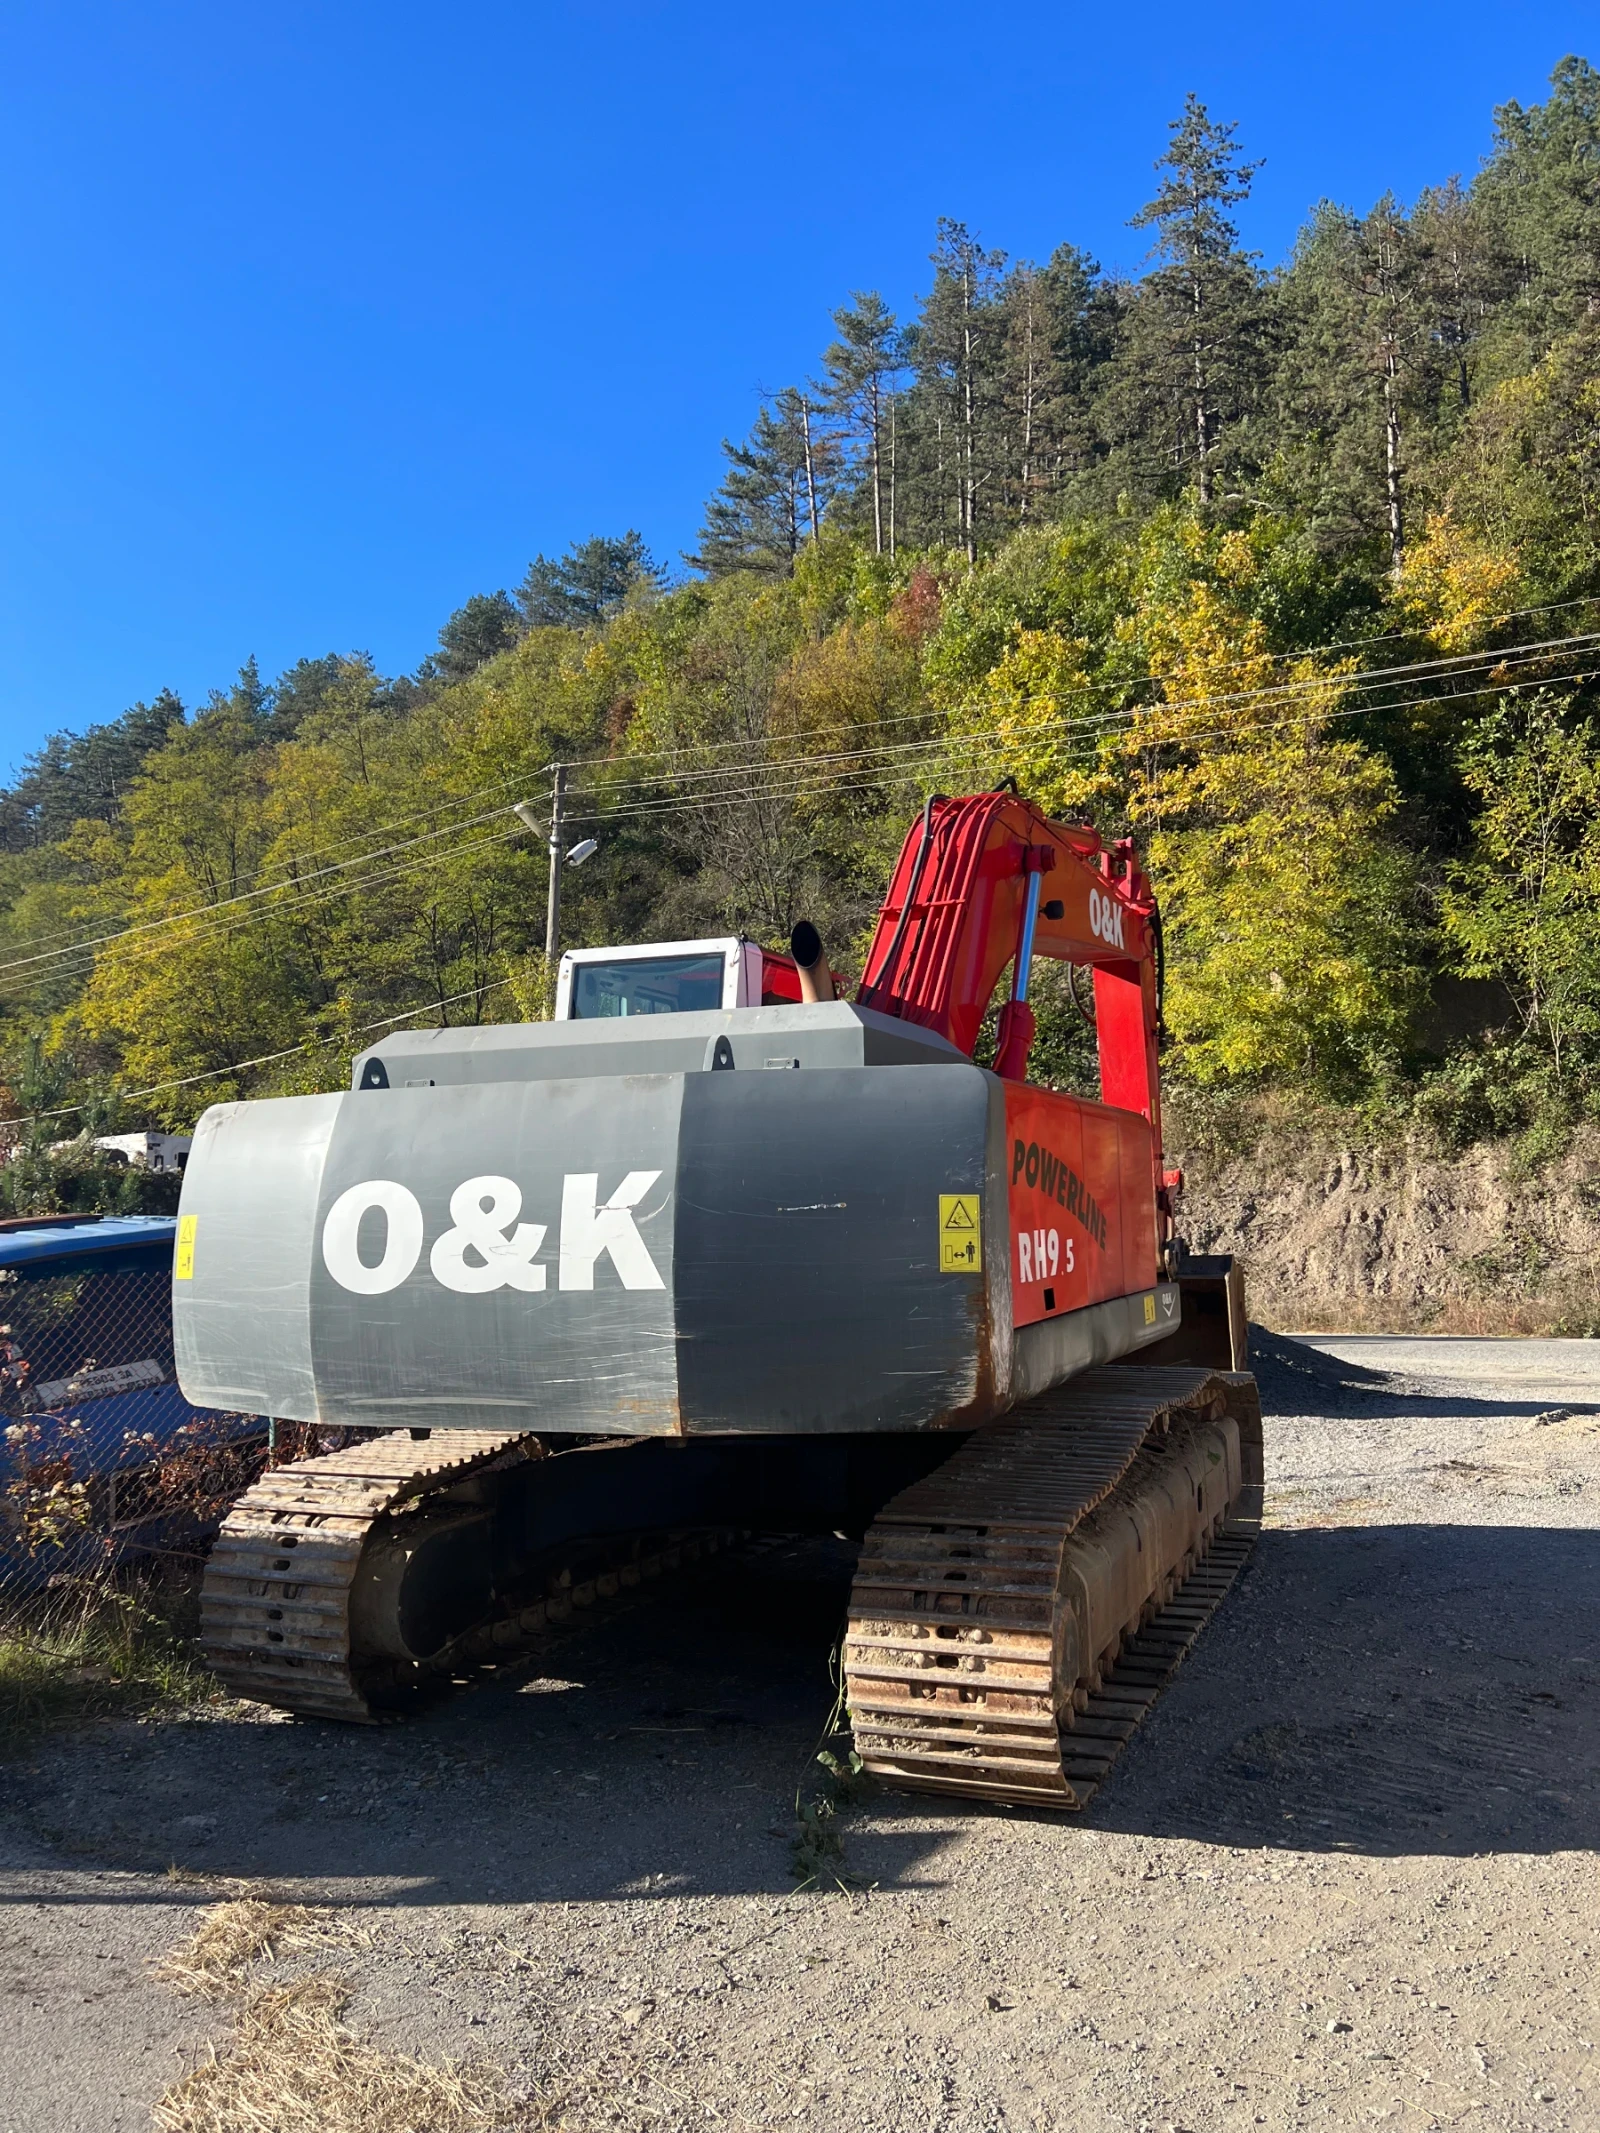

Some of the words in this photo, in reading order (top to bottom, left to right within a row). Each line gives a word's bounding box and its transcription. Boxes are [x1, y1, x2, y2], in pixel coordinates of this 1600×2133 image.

[1089, 888, 1125, 951] O&K
[322, 1170, 667, 1295] O&K
[1012, 1139, 1107, 1253] POWERLINE
[71, 1373, 115, 1388] РЕВОЗ
